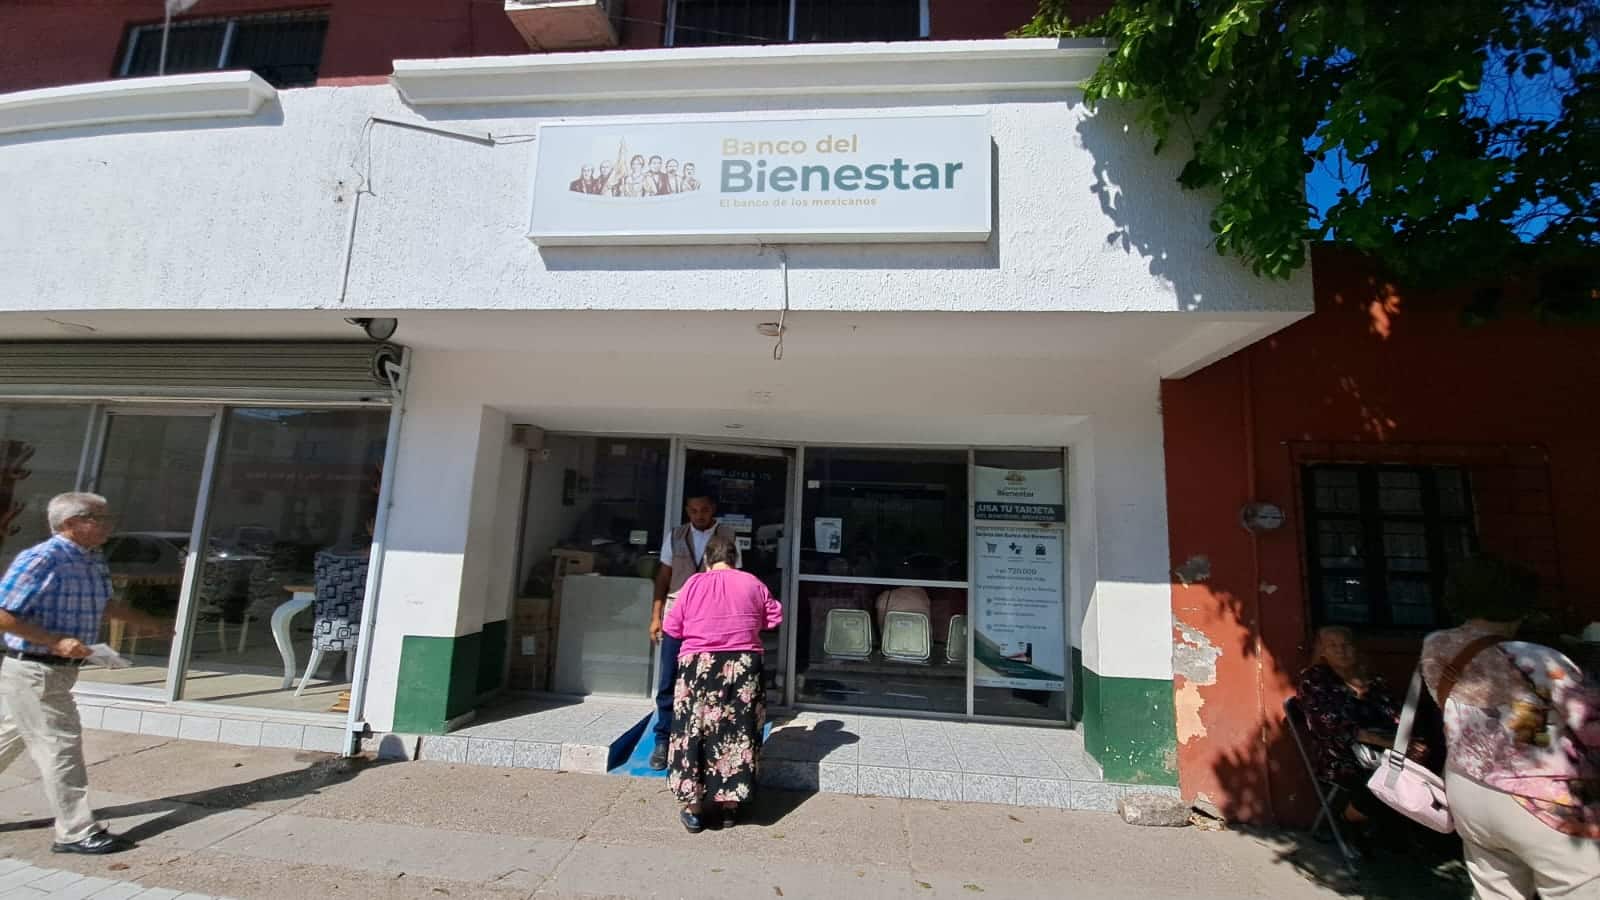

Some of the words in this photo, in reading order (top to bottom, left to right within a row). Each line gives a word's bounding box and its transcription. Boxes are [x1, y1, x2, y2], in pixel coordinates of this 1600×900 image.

[721, 137, 807, 156] Banco
[815, 133, 858, 154] del
[720, 158, 963, 193] Bienestar
[719, 199, 730, 208] El
[733, 198, 770, 208] banco
[773, 197, 788, 207] de
[791, 197, 808, 207] los
[811, 197, 878, 207] mexicanos
[1001, 505, 1012, 513] TU
[1015, 505, 1056, 514] TARJETA
